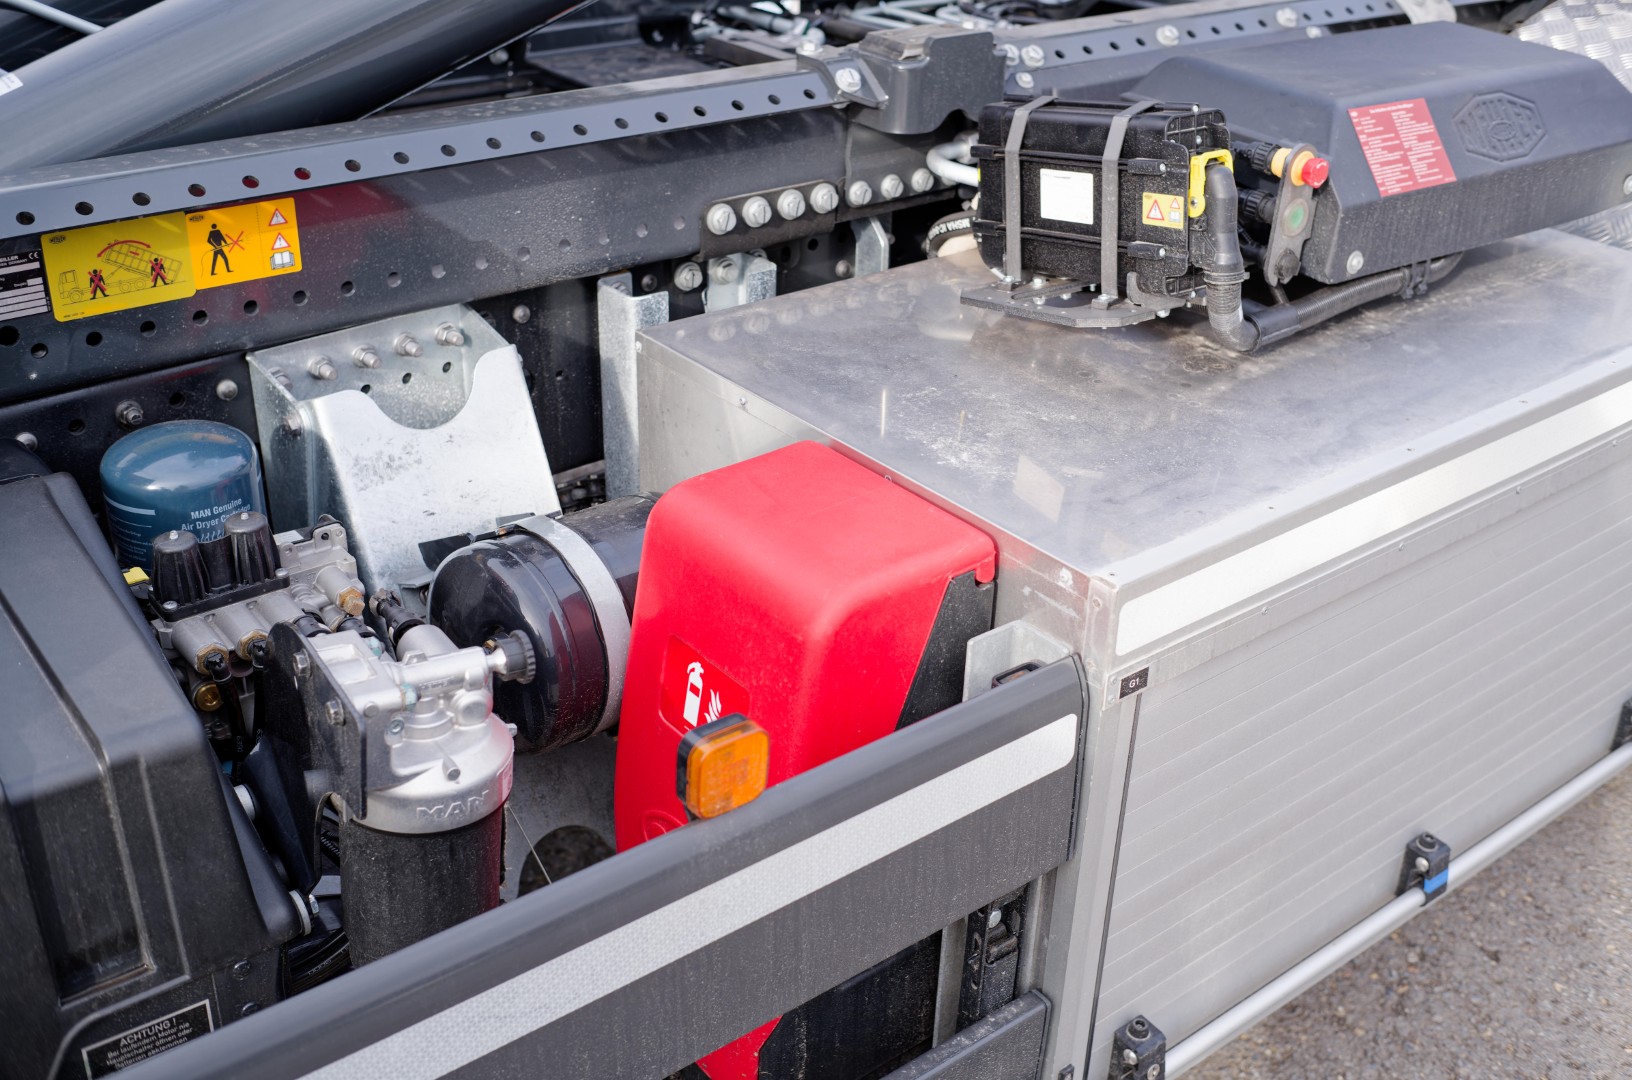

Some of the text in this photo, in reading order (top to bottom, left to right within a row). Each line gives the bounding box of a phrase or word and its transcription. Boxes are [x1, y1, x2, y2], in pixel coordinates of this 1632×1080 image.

[190, 498, 242, 519] MAN Genuine
[181, 523, 194, 531] Air
[196, 517, 219, 529] Dryer
[1129, 678, 1140, 688] G1
[416, 790, 489, 820] MAN
[106, 1044, 154, 1066] Hauptschalter
[178, 1027, 193, 1037] oder
[107, 1022, 190, 1059] Bei laufendem Motor nie
[120, 1020, 171, 1047] ACHTUNG
